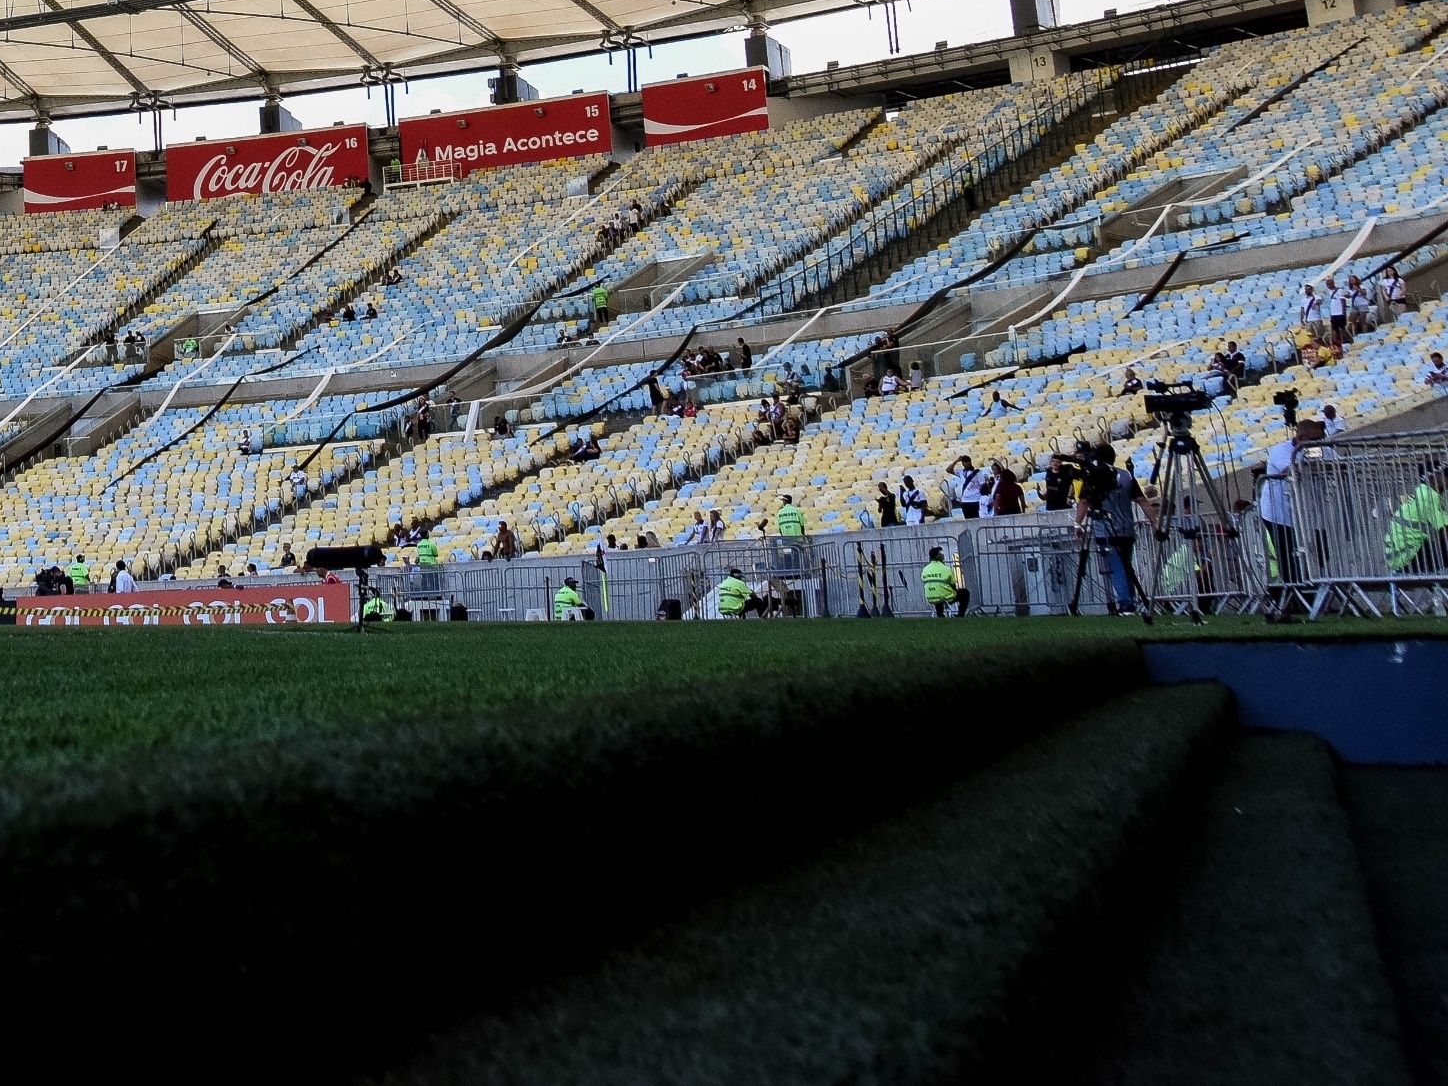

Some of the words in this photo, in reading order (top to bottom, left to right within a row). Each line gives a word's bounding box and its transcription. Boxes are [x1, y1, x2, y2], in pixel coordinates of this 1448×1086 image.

[1033, 56, 1047, 67] 13
[742, 78, 757, 92] 14
[585, 104, 599, 118] 15
[345, 137, 358, 149] 16
[435, 140, 497, 161] Magia
[502, 128, 599, 153] Acontece
[114, 160, 128, 172] 17
[193, 141, 342, 199] Coca-Cola
[265, 597, 335, 623] GOL
